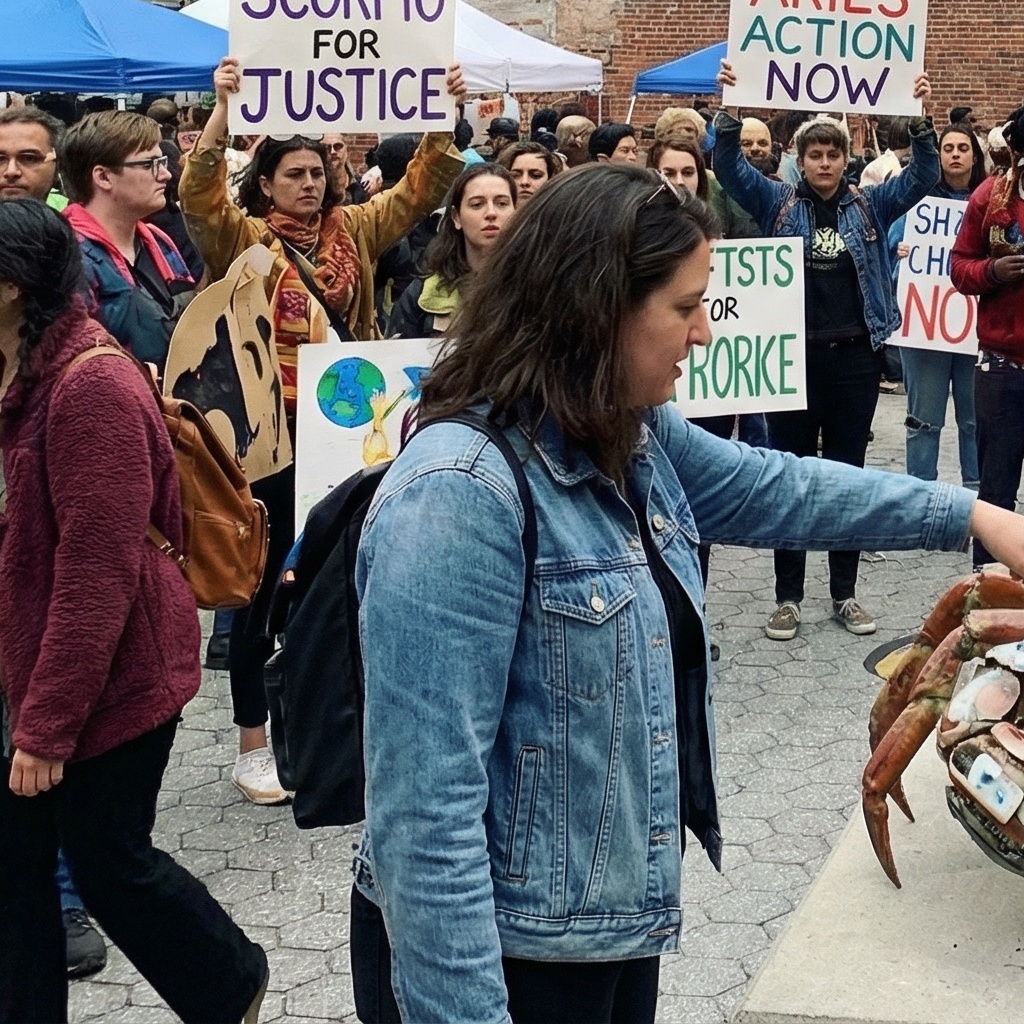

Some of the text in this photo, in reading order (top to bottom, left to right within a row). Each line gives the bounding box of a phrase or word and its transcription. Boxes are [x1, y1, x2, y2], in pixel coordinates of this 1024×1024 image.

[313, 28, 381, 60] FOR
[739, 14, 916, 63] ACTION
[240, 67, 447, 124] JUSTICE
[765, 59, 891, 107] NOW
[709, 244, 794, 288] TSTS
[702, 296, 740, 322] OR
[669, 333, 798, 403] RORKE
